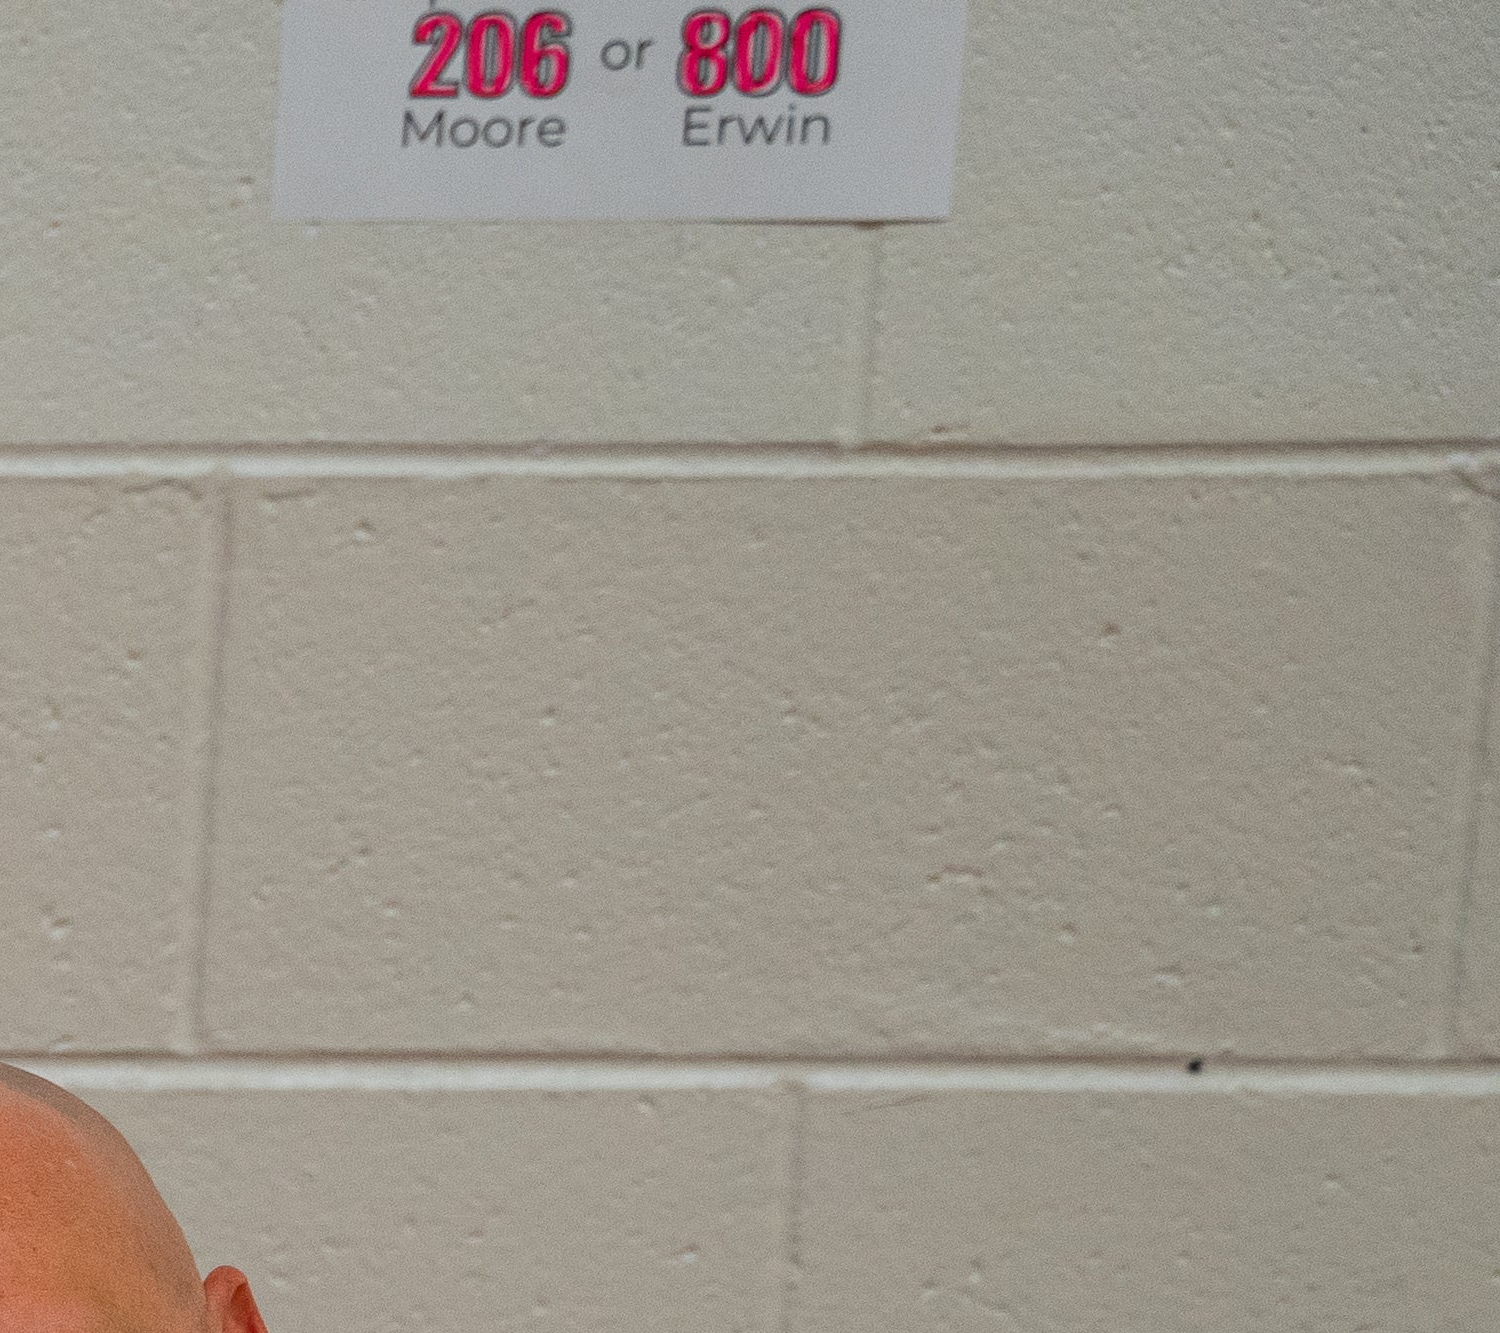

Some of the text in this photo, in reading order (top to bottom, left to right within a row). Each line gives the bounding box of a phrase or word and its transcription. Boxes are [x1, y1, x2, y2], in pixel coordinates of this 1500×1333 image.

[408, 6, 843, 100] 206 or 800
[401, 110, 567, 150] Moore
[682, 102, 831, 147] Erwin
